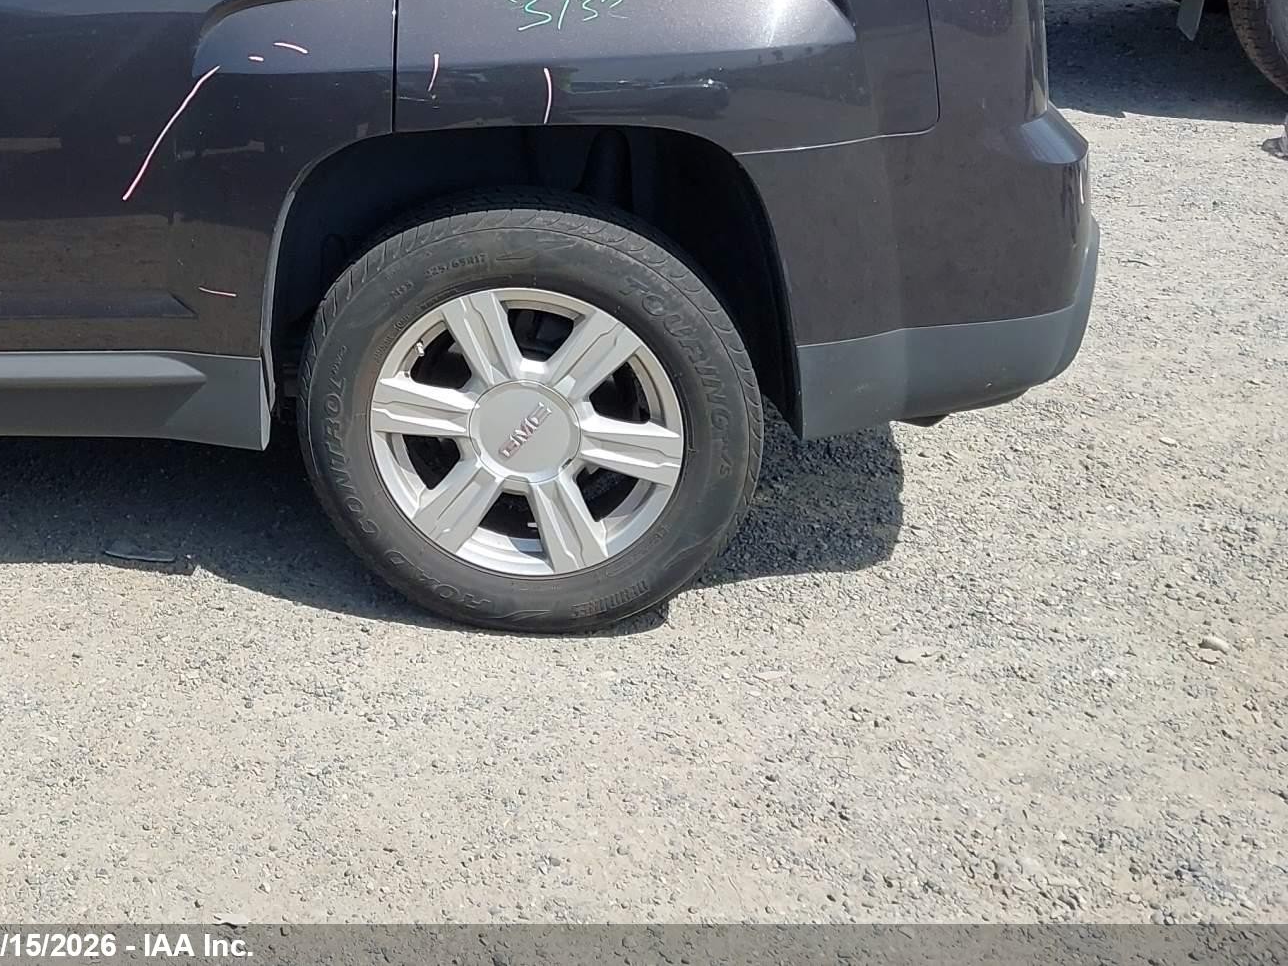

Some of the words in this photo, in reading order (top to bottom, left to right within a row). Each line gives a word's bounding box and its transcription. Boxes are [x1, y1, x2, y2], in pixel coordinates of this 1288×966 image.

[497, 400, 553, 459] GMC
[618, 276, 731, 431] TOURING
[321, 376, 381, 534] CONTROL
